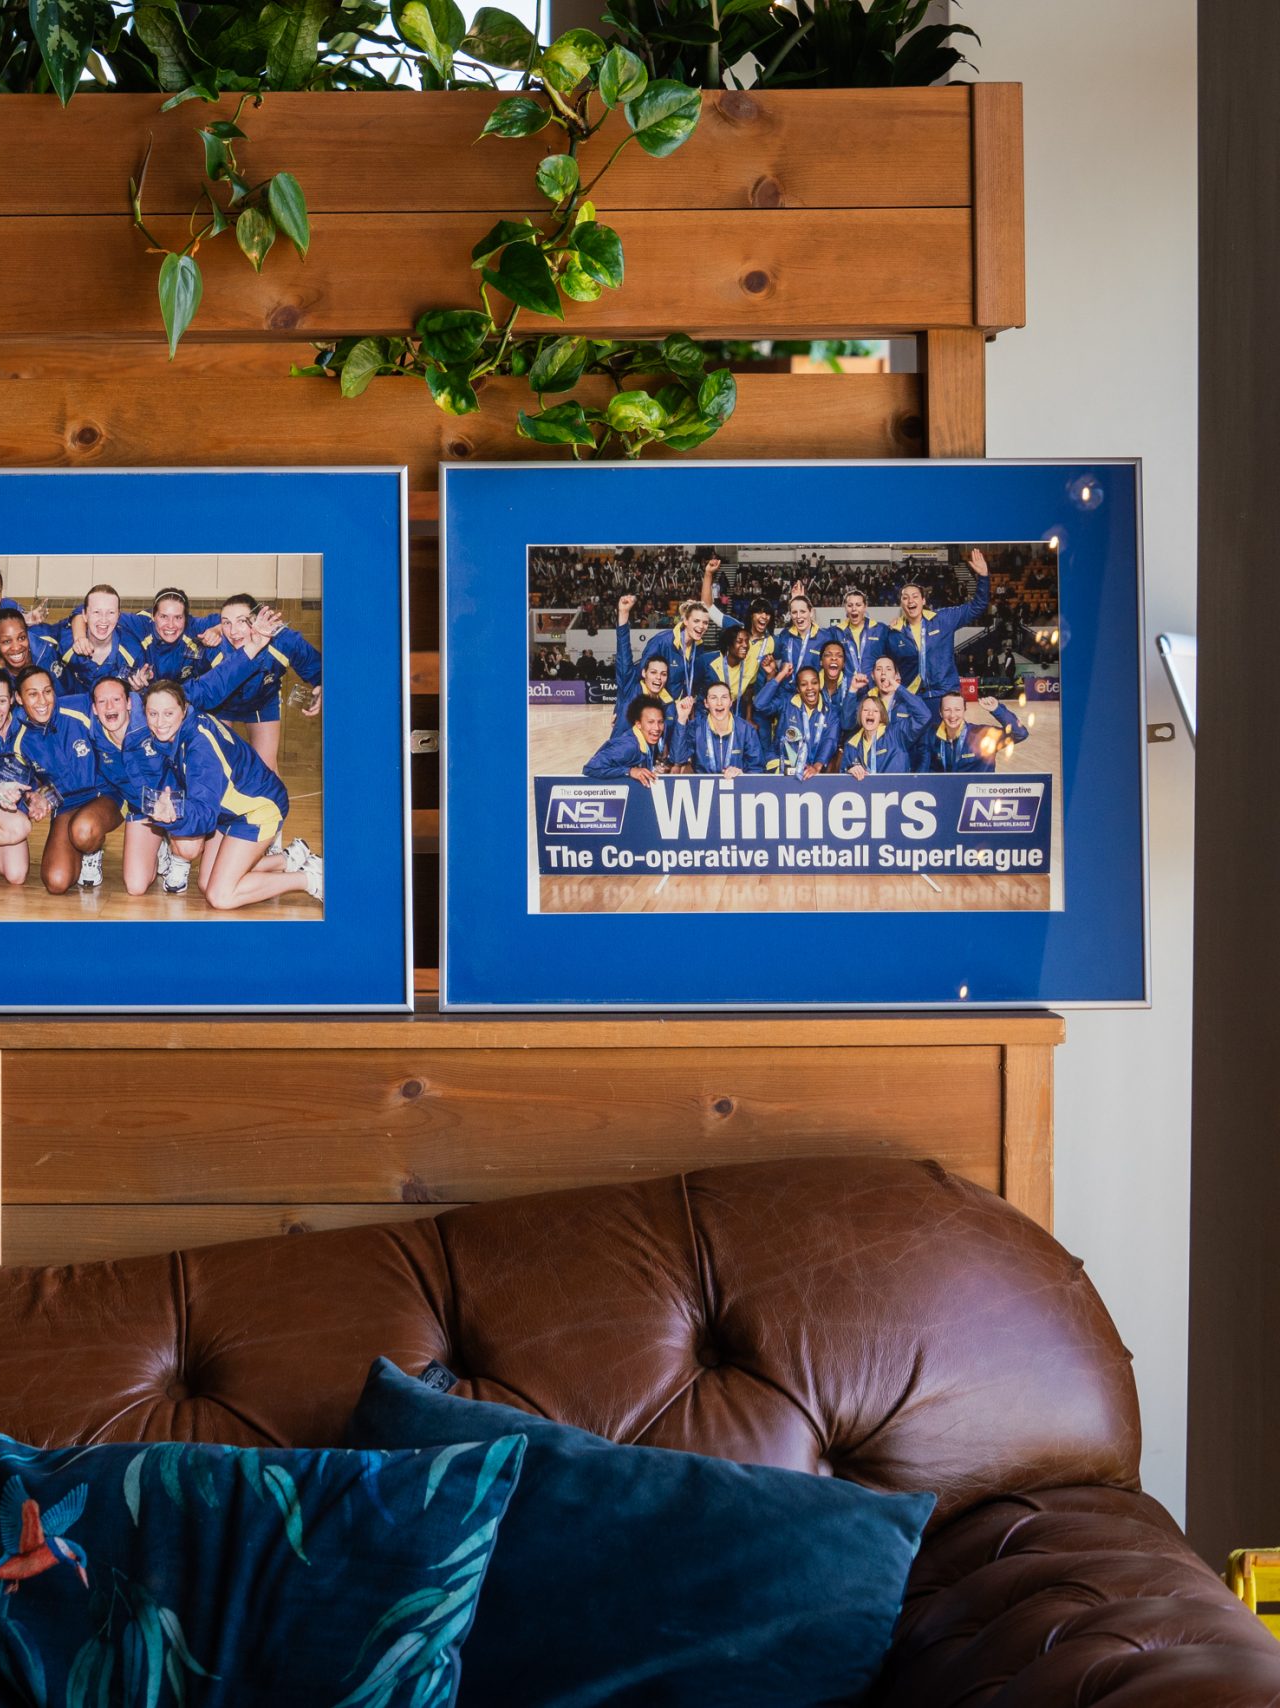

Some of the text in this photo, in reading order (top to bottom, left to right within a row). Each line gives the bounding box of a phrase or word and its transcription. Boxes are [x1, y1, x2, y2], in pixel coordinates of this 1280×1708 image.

[559, 788, 572, 796] The
[975, 786, 987, 794] The
[556, 801, 617, 823] NSL
[649, 778, 938, 841] Winners
[970, 799, 1031, 822] NSL
[544, 843, 1043, 873] The Co-operative Netball Superleague
